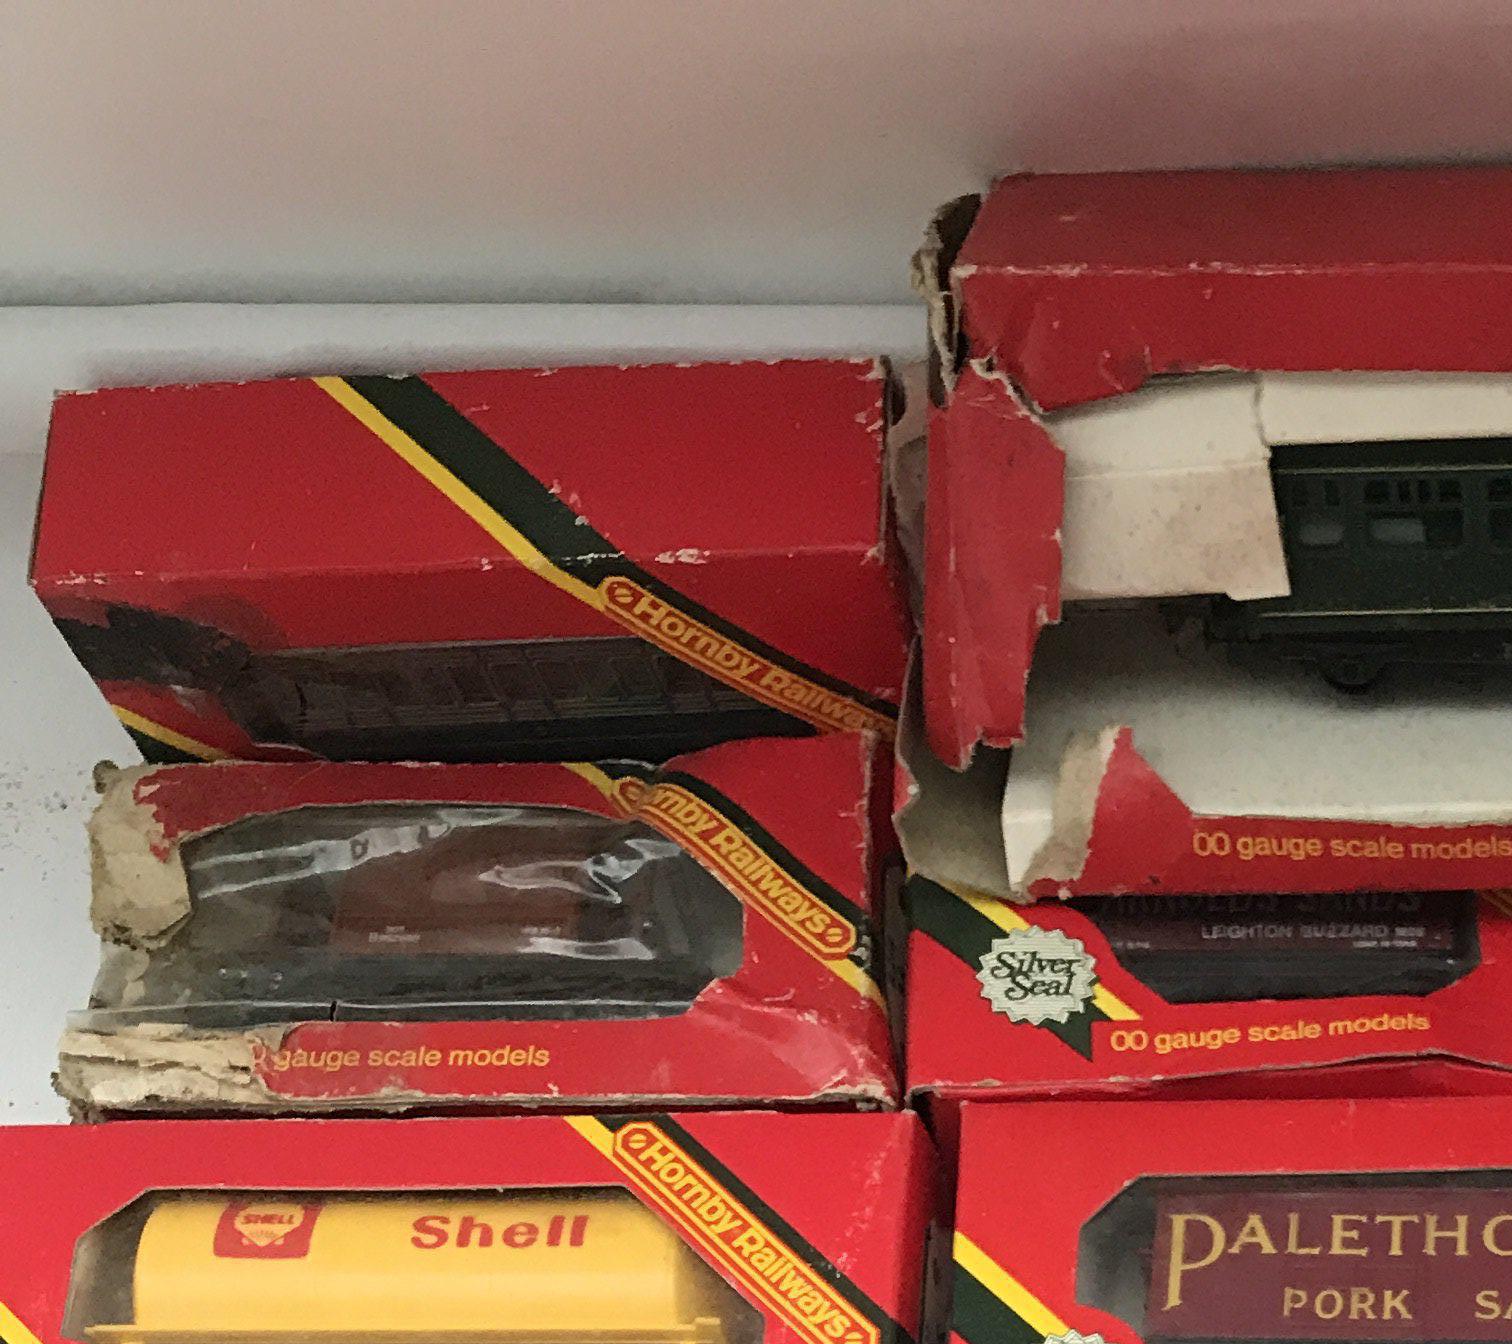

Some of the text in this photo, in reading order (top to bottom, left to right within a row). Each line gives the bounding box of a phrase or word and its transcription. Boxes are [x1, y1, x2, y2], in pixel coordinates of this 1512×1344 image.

[633, 594, 761, 680] Hornby
[1236, 835, 1323, 860] gauge
[1330, 837, 1405, 859] scale
[709, 827, 831, 934] Railways
[1201, 923, 1294, 940] LEIGHTON
[1301, 923, 1391, 940] BUZZARD
[990, 951, 1082, 979] Silver
[1004, 971, 1075, 1001] Seal
[1154, 1025, 1242, 1055] gauge
[1248, 1019, 1323, 1044] scale
[1328, 1012, 1432, 1036] models
[271, 1049, 361, 1073] gauge
[367, 1047, 442, 1068] scale
[448, 1044, 551, 1068] models
[240, 1213, 295, 1226] SHELL
[410, 1214, 590, 1250] Shell
[638, 1140, 851, 1339] Hornby Railways
[1281, 1286, 1414, 1323] PORK
